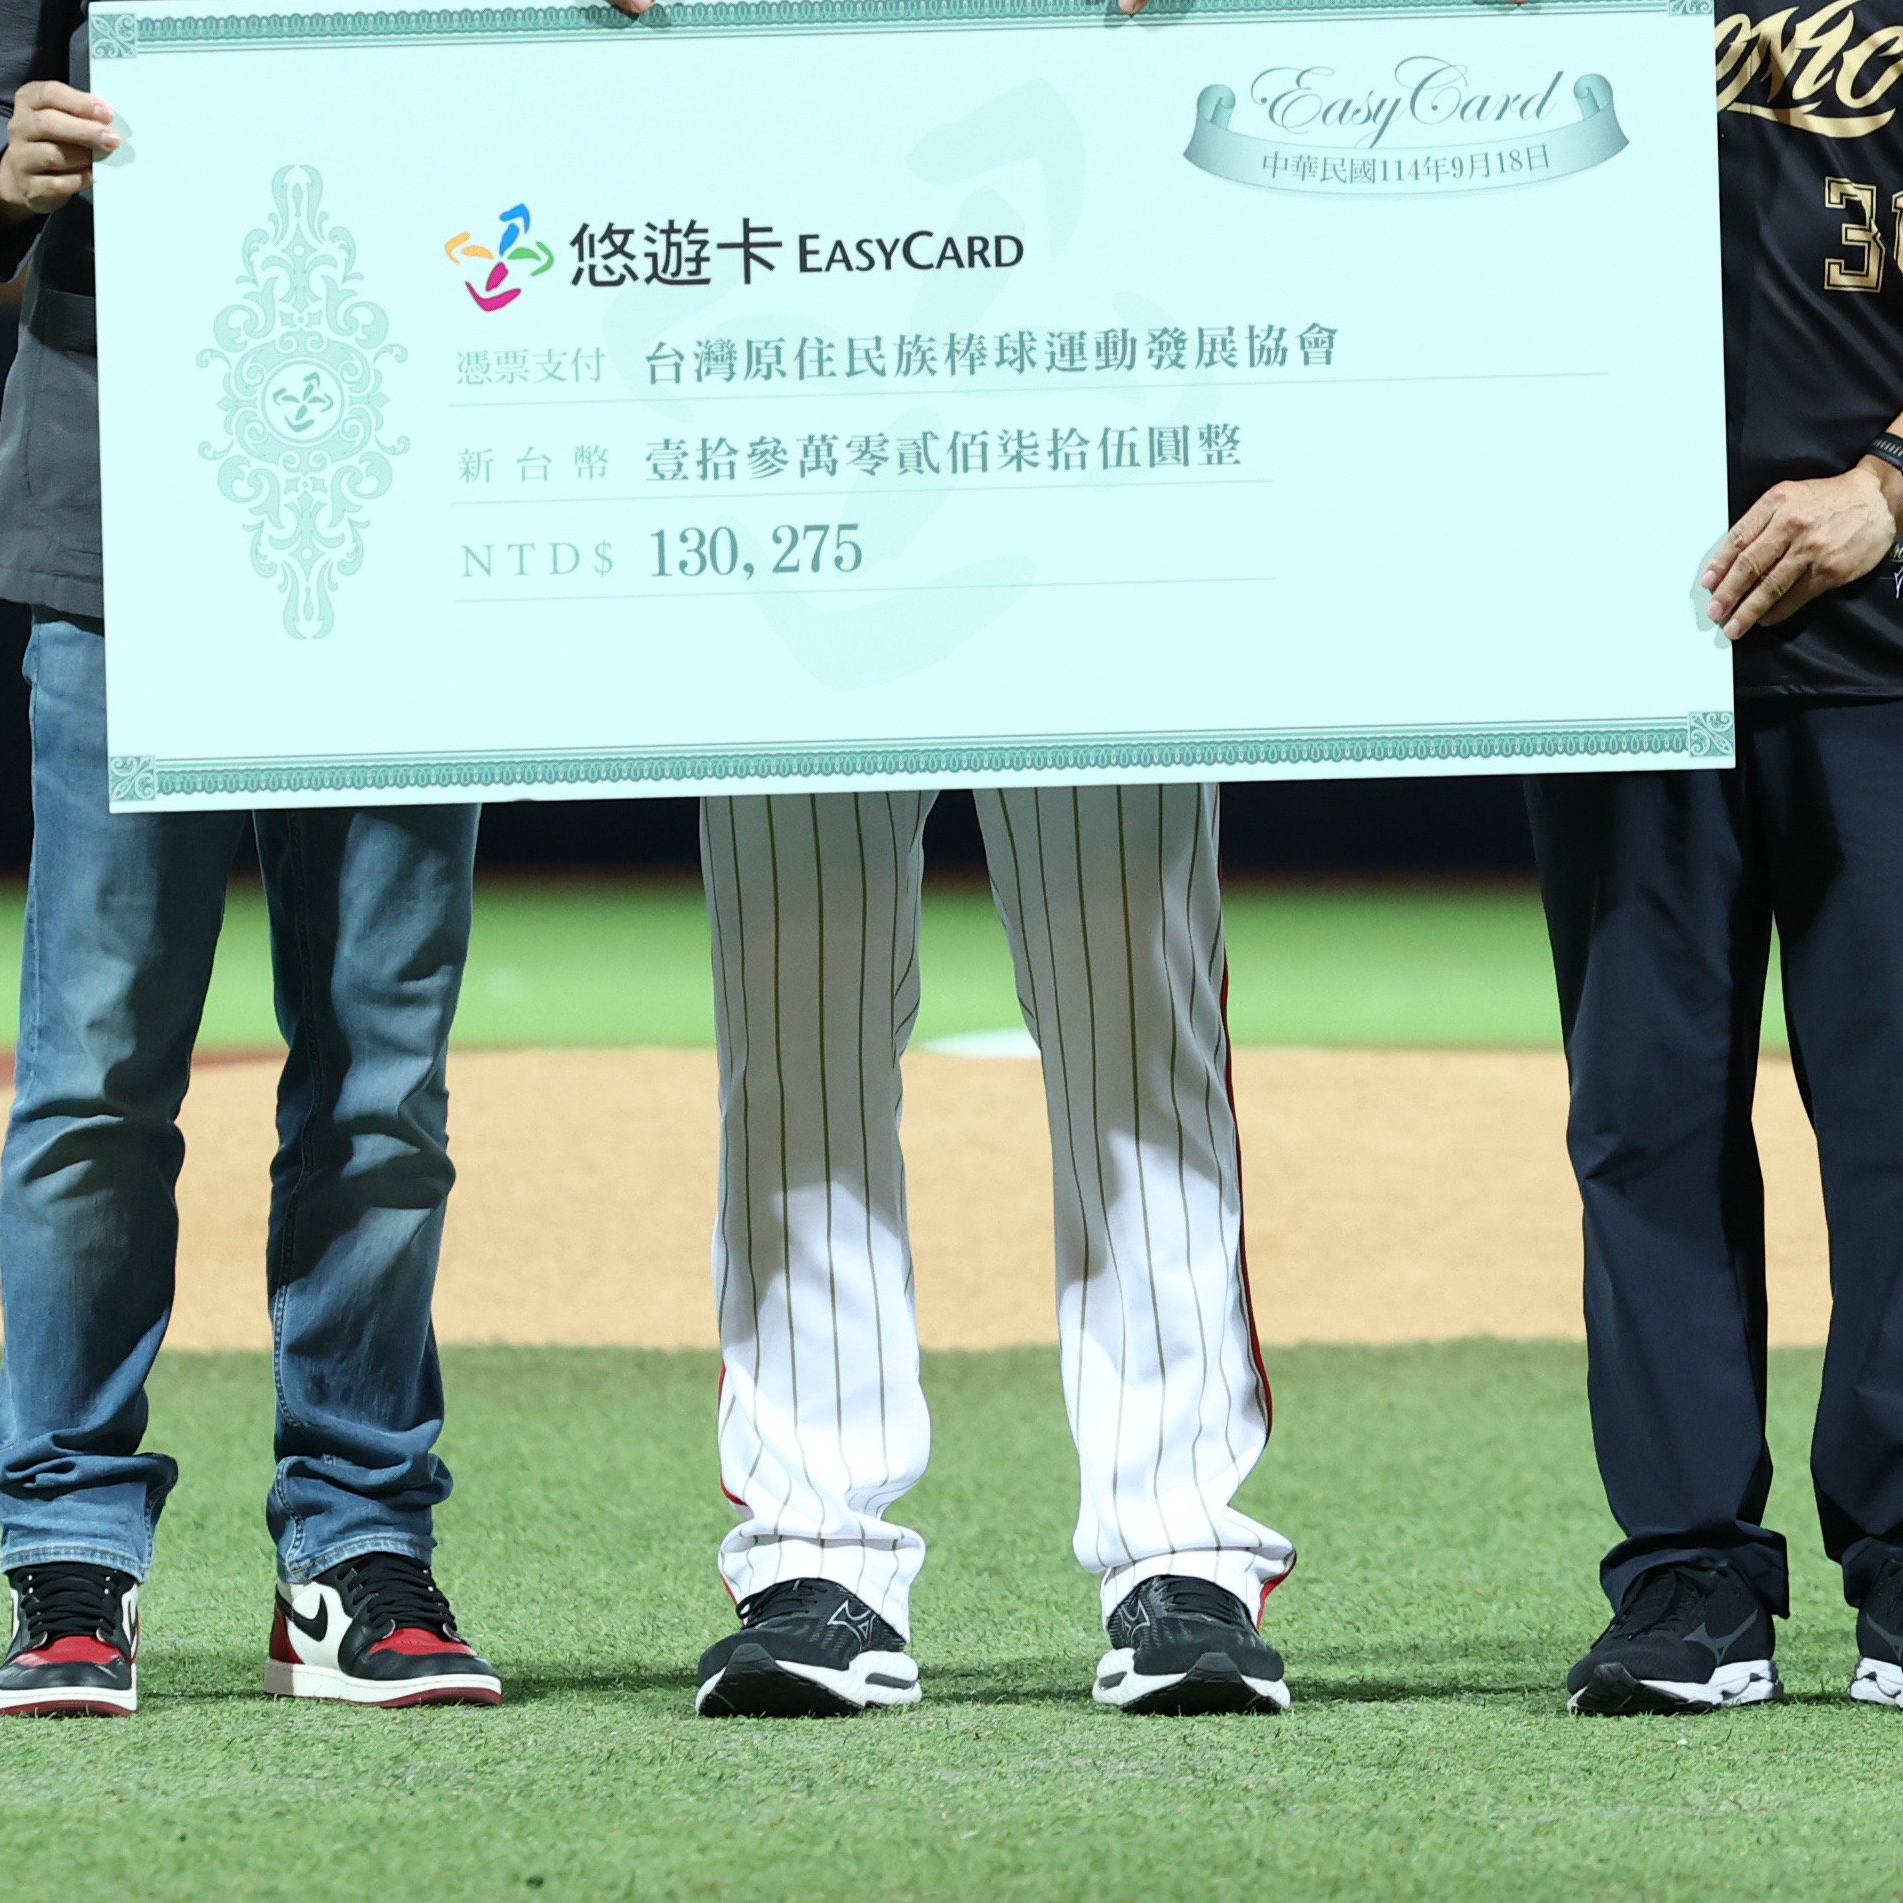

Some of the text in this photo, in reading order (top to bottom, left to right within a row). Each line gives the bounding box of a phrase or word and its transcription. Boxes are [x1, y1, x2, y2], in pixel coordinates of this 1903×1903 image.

[1250, 55, 1564, 149] EasyCard
[1262, 144, 1550, 184] 中華民國114年9月18日
[569, 218, 783, 287] 悠遊卡
[456, 322, 1338, 385] 憑票支付 台灣原住民族棒球運動發展協會
[458, 423, 1241, 483] 新台幣 壹拾參萬零貳佰柒拾伍圓整
[460, 540, 613, 578] NTD$
